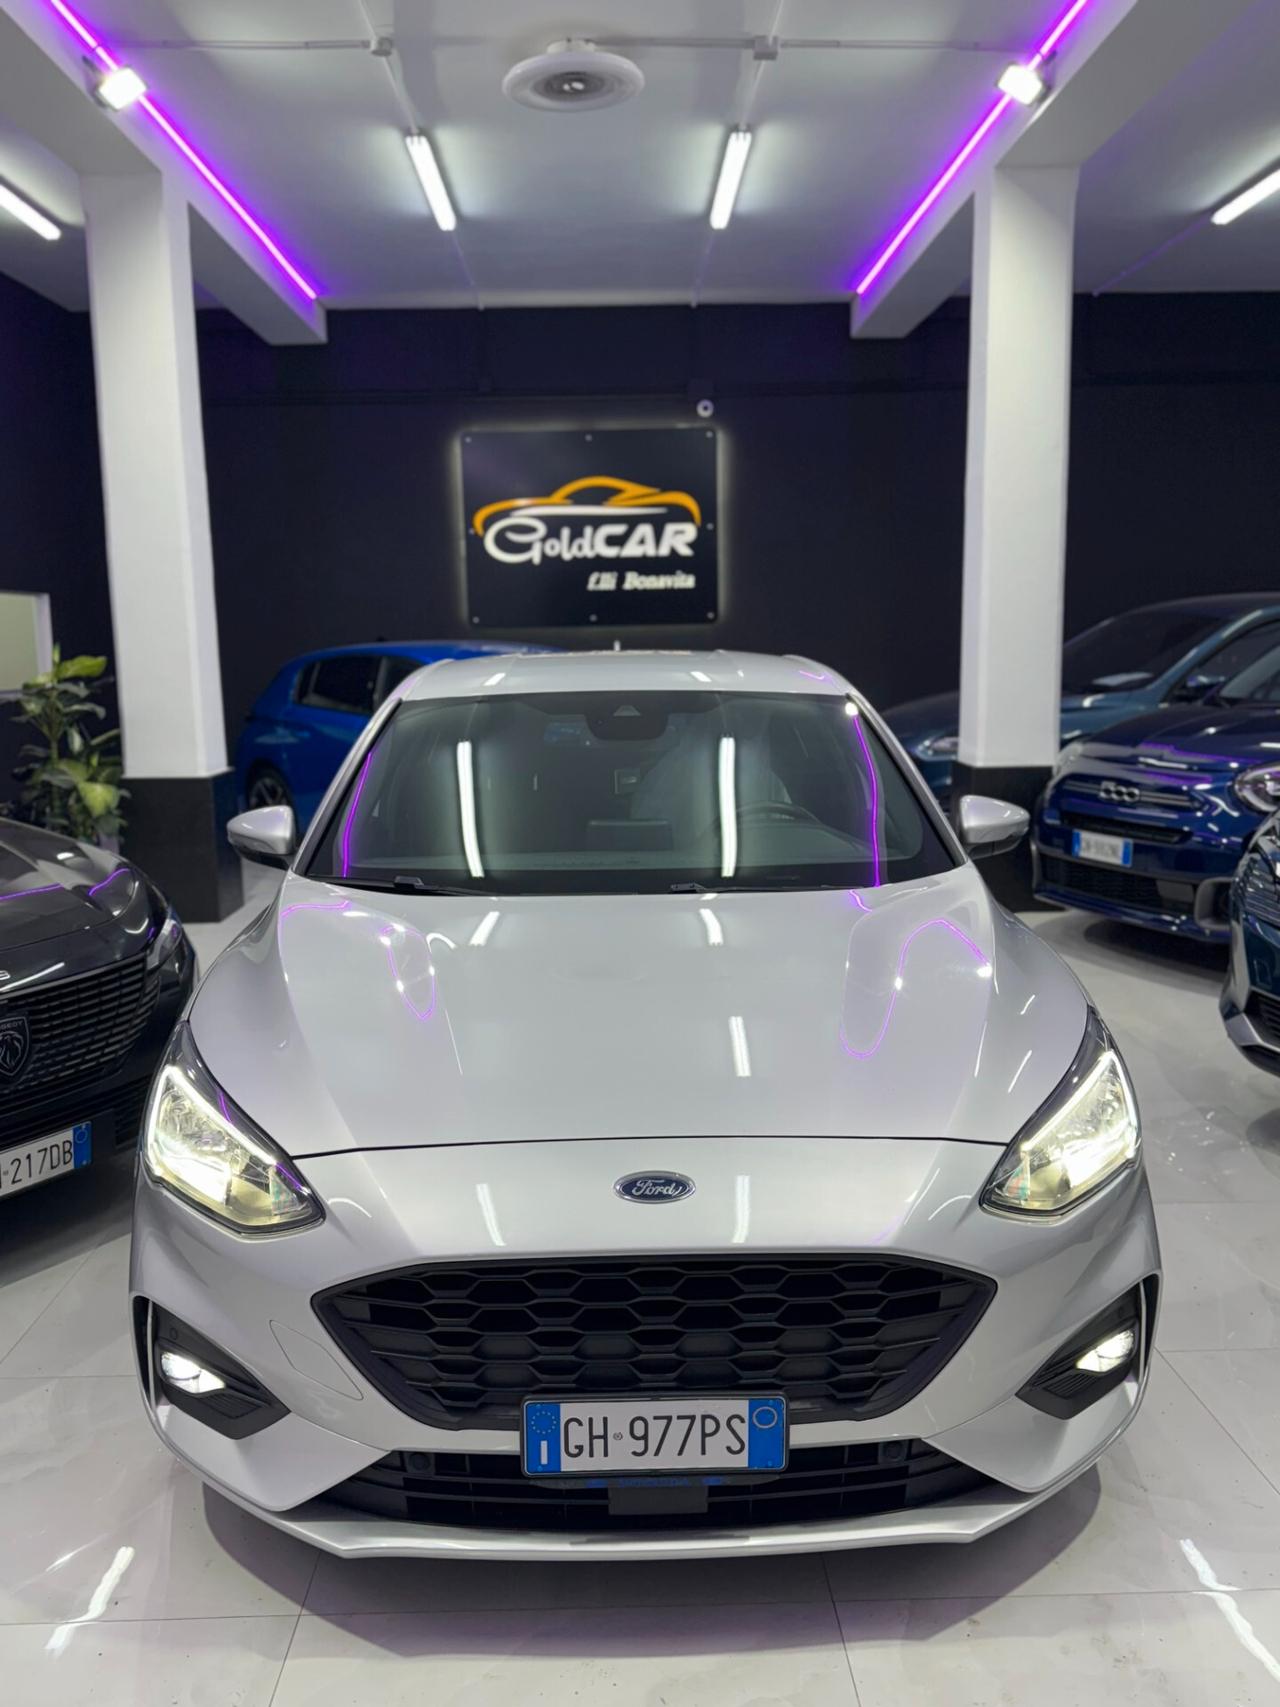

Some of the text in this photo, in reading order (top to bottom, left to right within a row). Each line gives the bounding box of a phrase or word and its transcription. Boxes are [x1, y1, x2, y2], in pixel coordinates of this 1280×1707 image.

[484, 516, 698, 565] GoldCAR
[1099, 780, 1140, 803] 500
[631, 1180, 682, 1197] Ford
